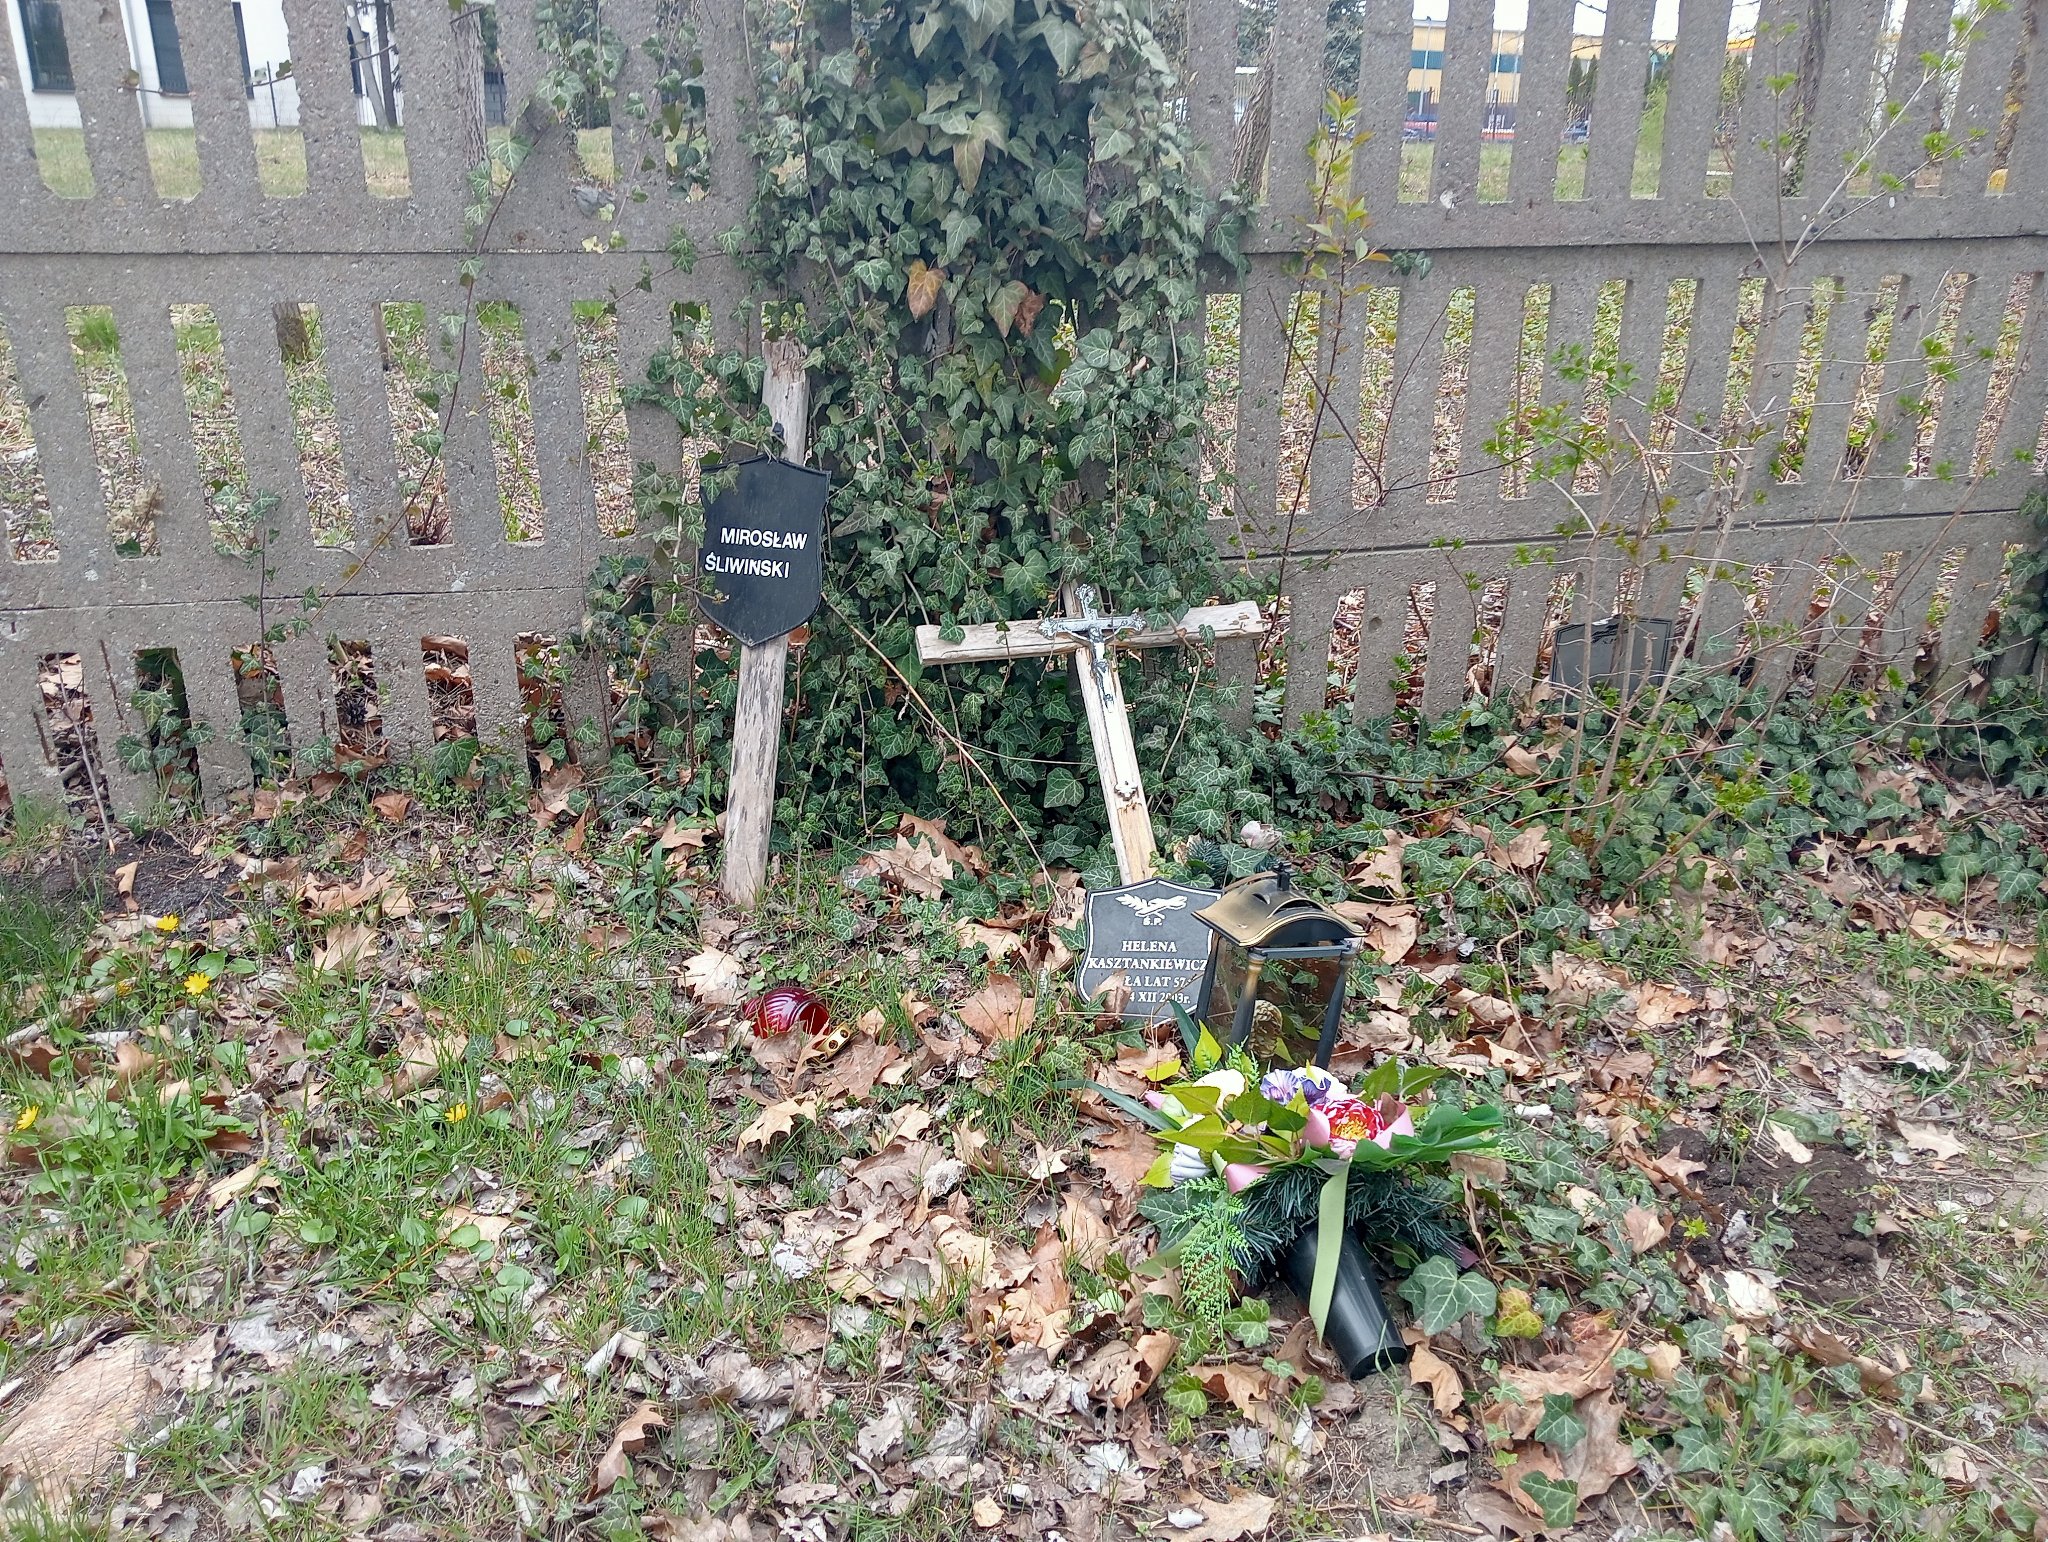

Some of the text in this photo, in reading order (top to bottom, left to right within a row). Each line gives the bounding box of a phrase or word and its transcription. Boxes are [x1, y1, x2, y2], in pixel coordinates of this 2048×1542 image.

[721, 527, 807, 550] MIROSŁAW
[1121, 940, 1178, 953] HELENA
[1088, 957, 1207, 971] KASZTANKIEWICZ
[1124, 976, 1142, 987] ŁA
[1145, 976, 1171, 988] LAT
[1138, 991, 1157, 1003] XII
